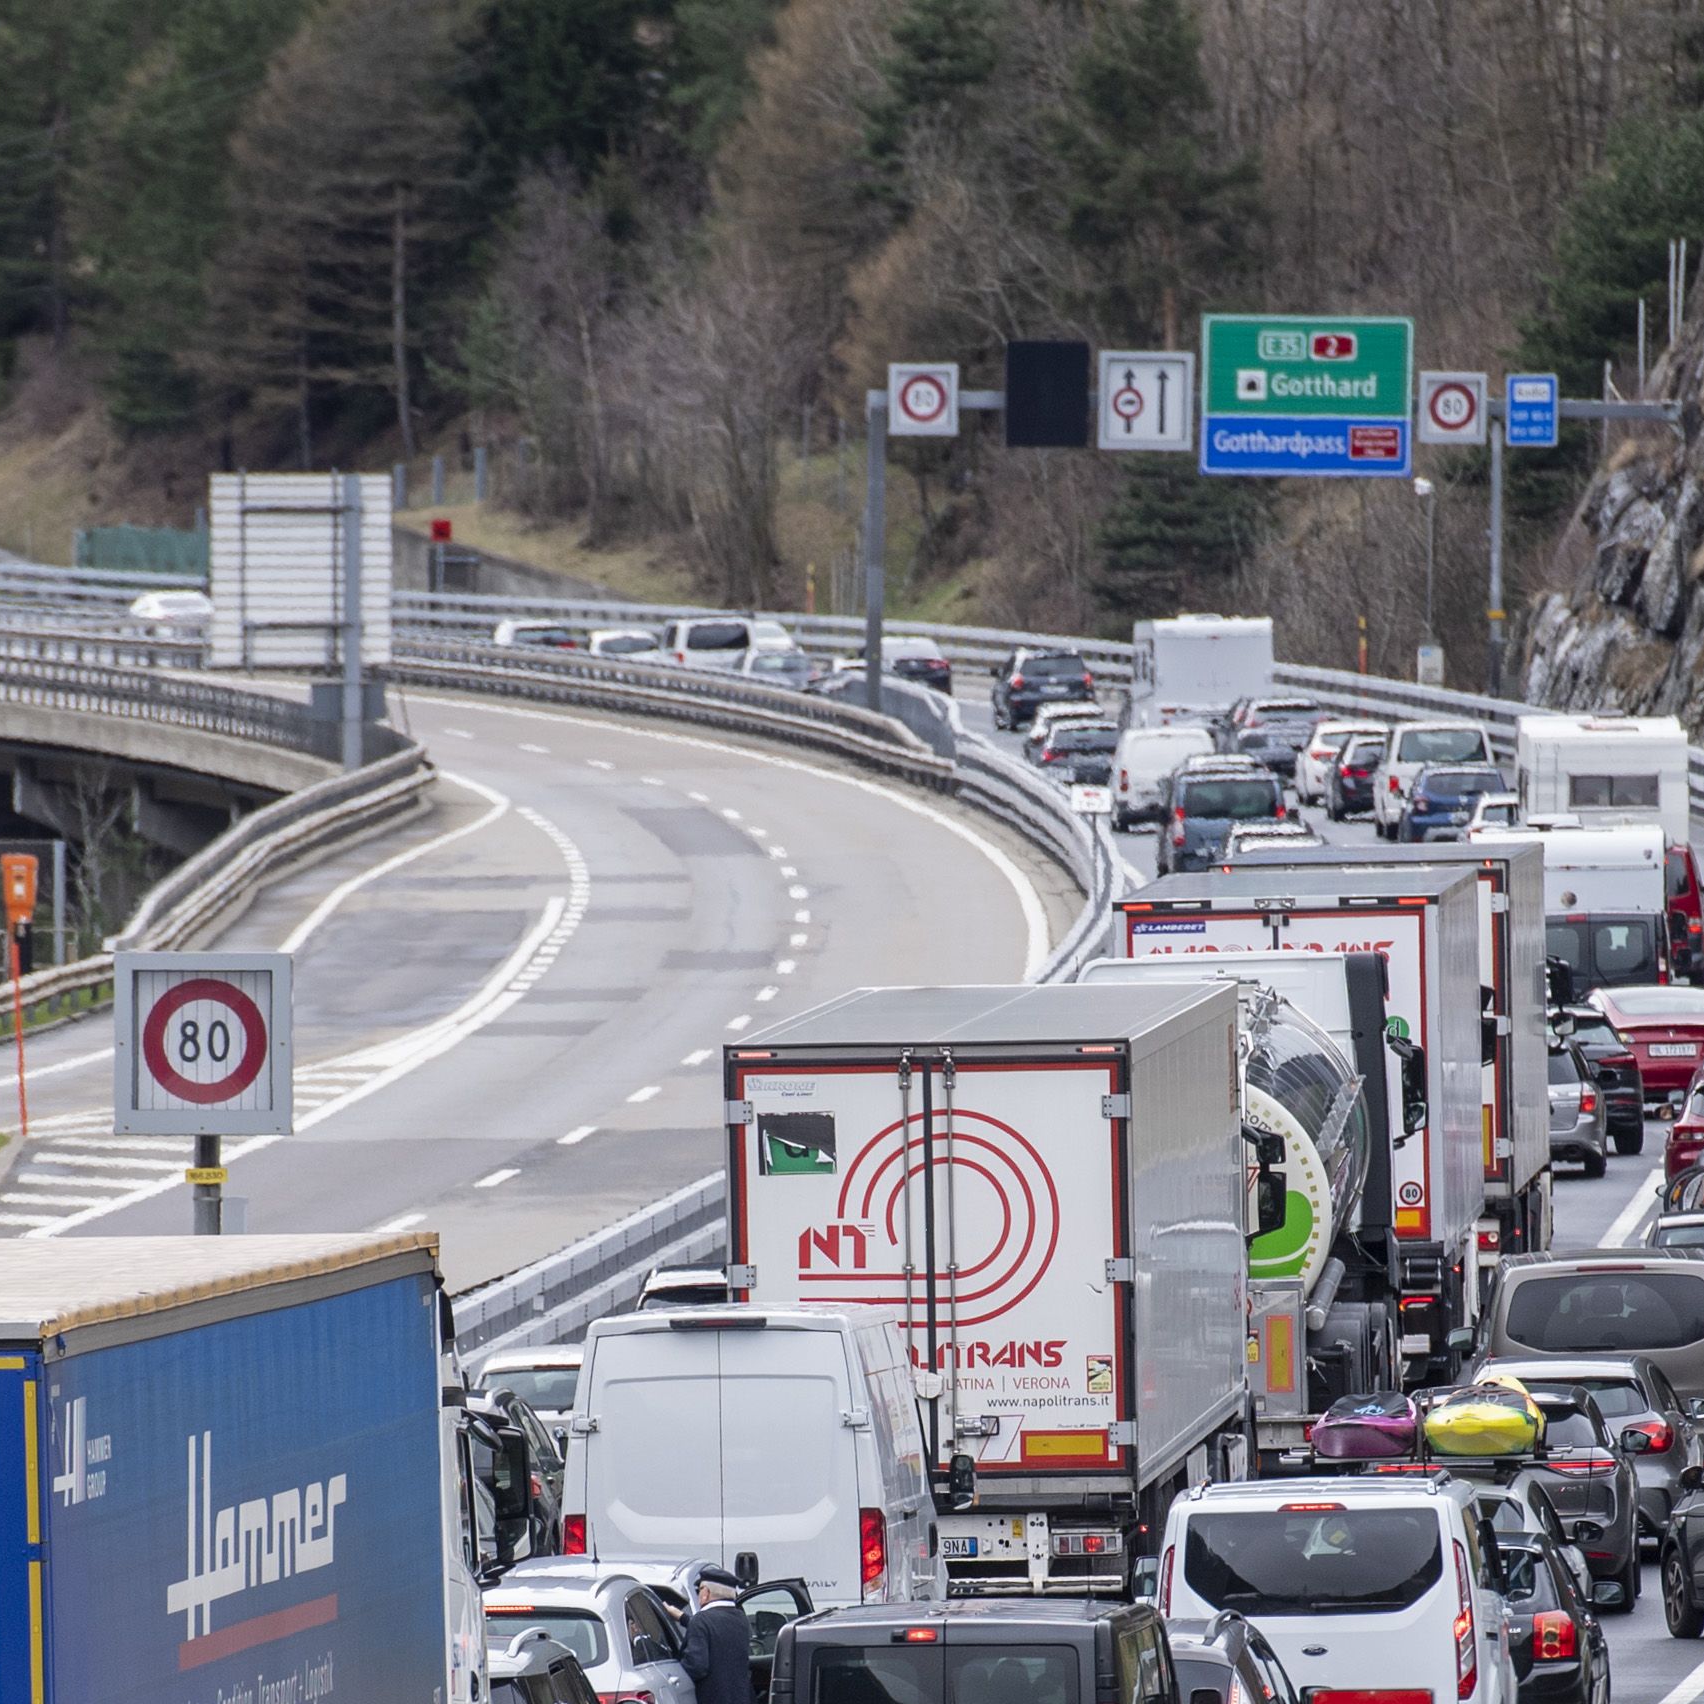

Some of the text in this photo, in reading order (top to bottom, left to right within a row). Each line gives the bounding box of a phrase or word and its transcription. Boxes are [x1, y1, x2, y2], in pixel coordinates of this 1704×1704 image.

[1326, 336, 1339, 356] 2
[1271, 372, 1378, 398] Gotthard
[1442, 398, 1463, 416] 80
[1213, 430, 1345, 459] Gotthardpass
[1147, 922, 1204, 932] LAMBERET
[179, 1020, 230, 1063] 80
[1405, 1188, 1418, 1199] 80
[798, 1224, 866, 1269] NT
[946, 1376, 1070, 1391] LATINA VERONA
[987, 1394, 1110, 1409] www.napolitrans.it
[167, 1430, 347, 1641] Hammer
